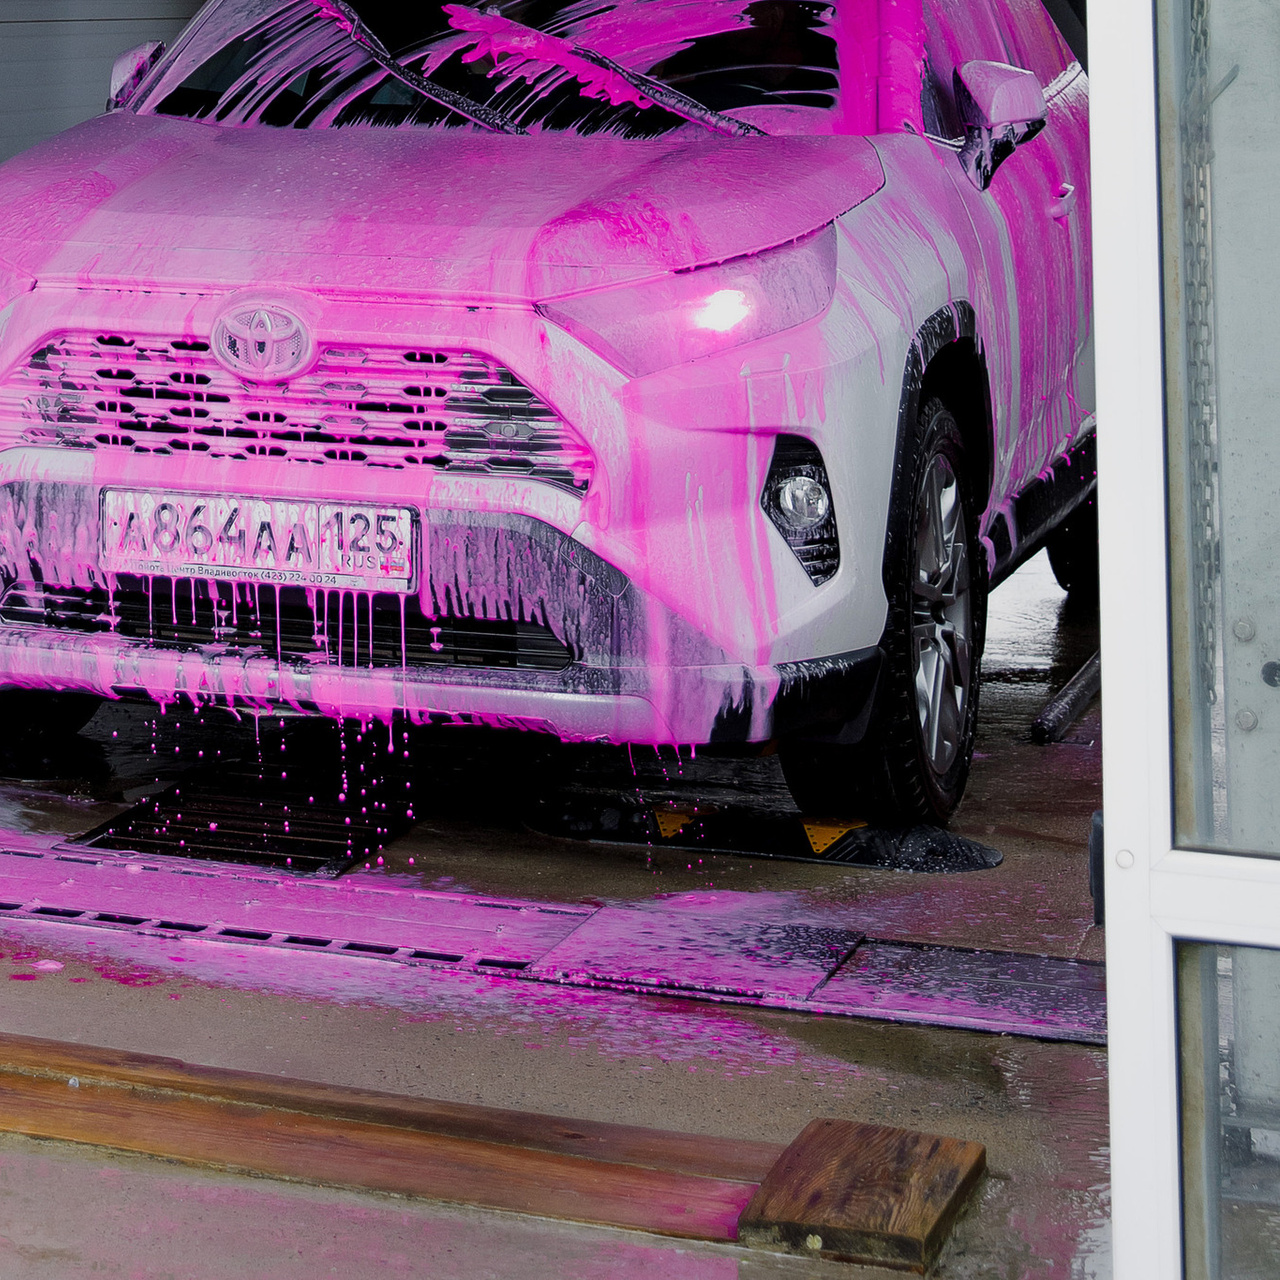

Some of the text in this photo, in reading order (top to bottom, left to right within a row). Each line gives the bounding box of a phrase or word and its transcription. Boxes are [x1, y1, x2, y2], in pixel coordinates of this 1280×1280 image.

[323, 509, 398, 555] 125
[341, 553, 376, 570] RUS
[260, 571, 288, 583] (423)
[325, 575, 337, 586] 24
